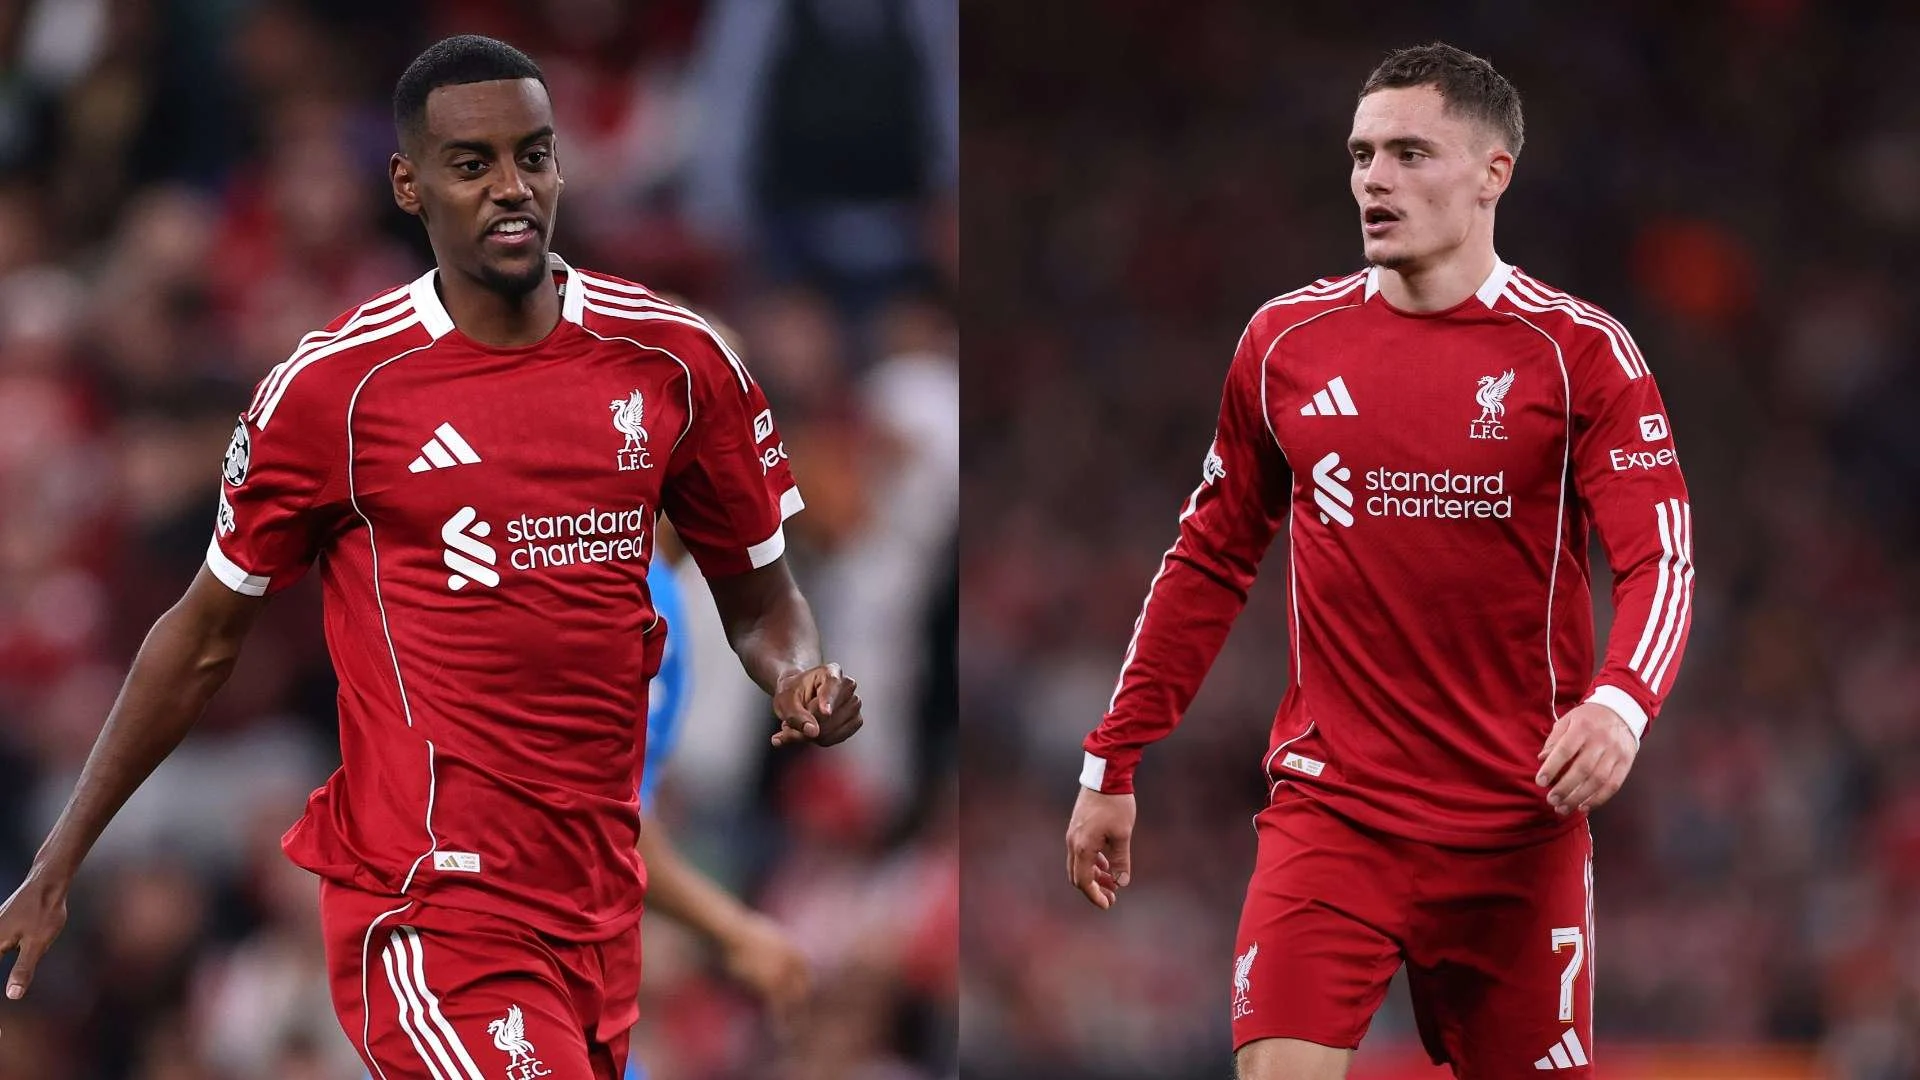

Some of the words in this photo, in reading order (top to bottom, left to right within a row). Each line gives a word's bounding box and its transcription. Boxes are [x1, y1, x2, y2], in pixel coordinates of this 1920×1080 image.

[1470, 424, 1508, 440] L.F.C.
[616, 452, 654, 472] L.F.C.
[1366, 467, 1504, 495] standard
[1366, 494, 1512, 519] chartered
[506, 504, 644, 543] standard
[510, 530, 645, 570] chartered
[1551, 926, 1584, 1023] 7
